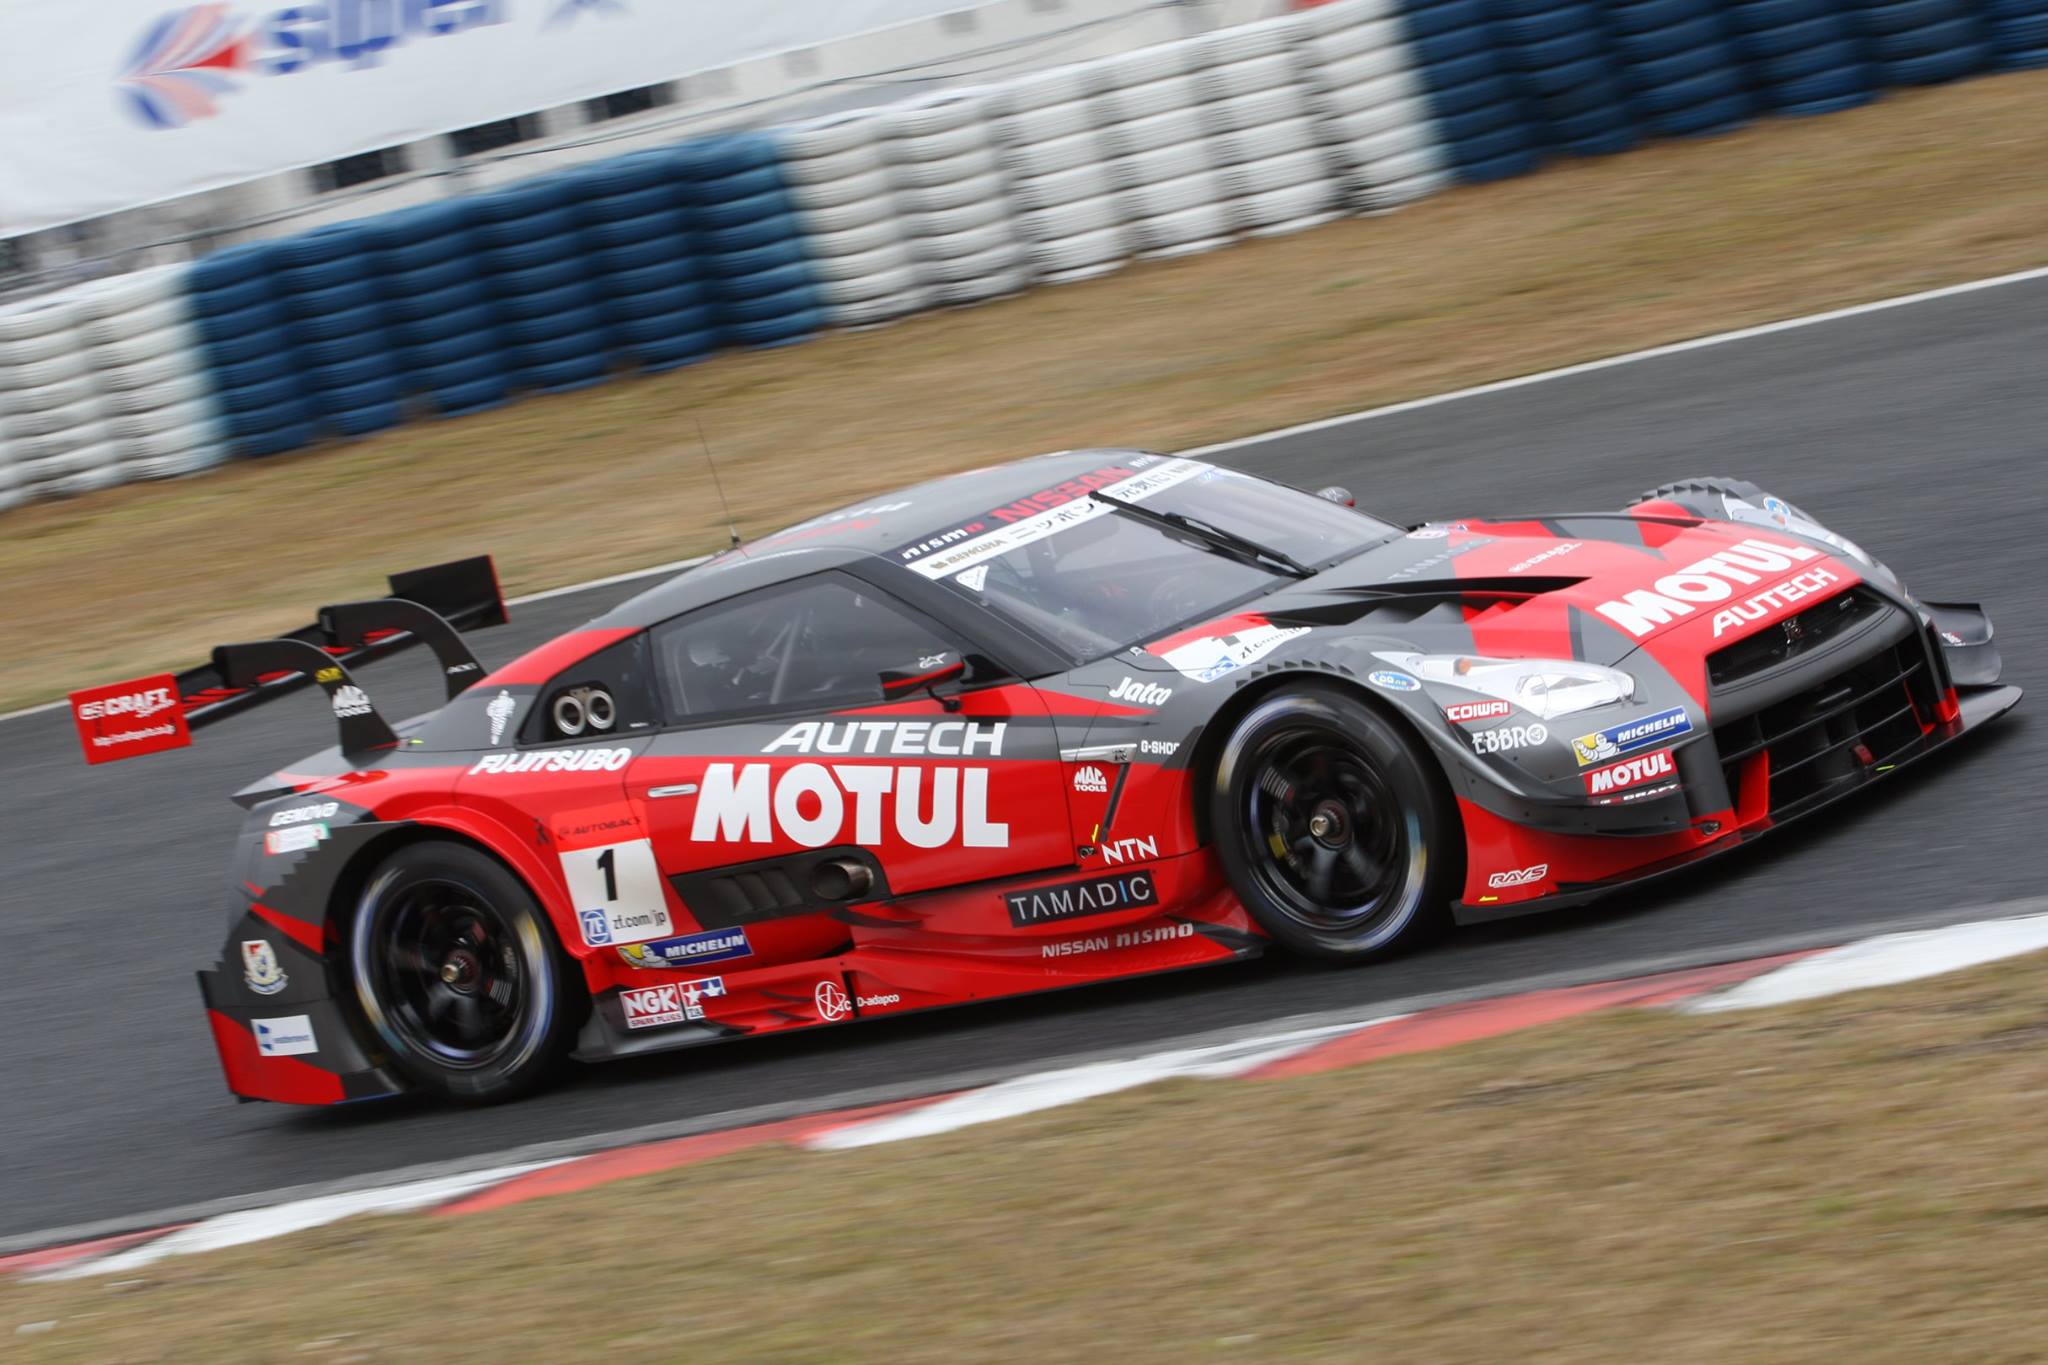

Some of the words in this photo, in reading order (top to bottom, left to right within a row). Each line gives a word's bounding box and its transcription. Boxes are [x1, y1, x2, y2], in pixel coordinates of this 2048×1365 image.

[988, 466, 1135, 524] NISSAN
[1595, 539, 1820, 637] MOTUL
[1713, 567, 1839, 638] AUTECH
[1109, 677, 1172, 706] Jatco
[761, 721, 1008, 756] AUTECH
[1472, 723, 1548, 755] EBBRO
[1618, 712, 1686, 743] MICHELIN
[468, 747, 632, 775] FUJITSUBO
[1074, 765, 1107, 785] MAC
[1591, 753, 1672, 794] MOTUL
[1074, 784, 1108, 792] TOOLS
[690, 763, 1008, 848] MOTUL
[1101, 835, 1159, 865] NTN
[597, 848, 618, 902] 1
[1489, 864, 1548, 888] RAYS
[1010, 877, 1150, 920] TAMADIC
[583, 913, 609, 941] ZF
[1042, 937, 1109, 958] NISSAN
[1116, 923, 1194, 948] nismo
[664, 934, 745, 958] MICHELIN
[623, 987, 679, 1016] NGK
